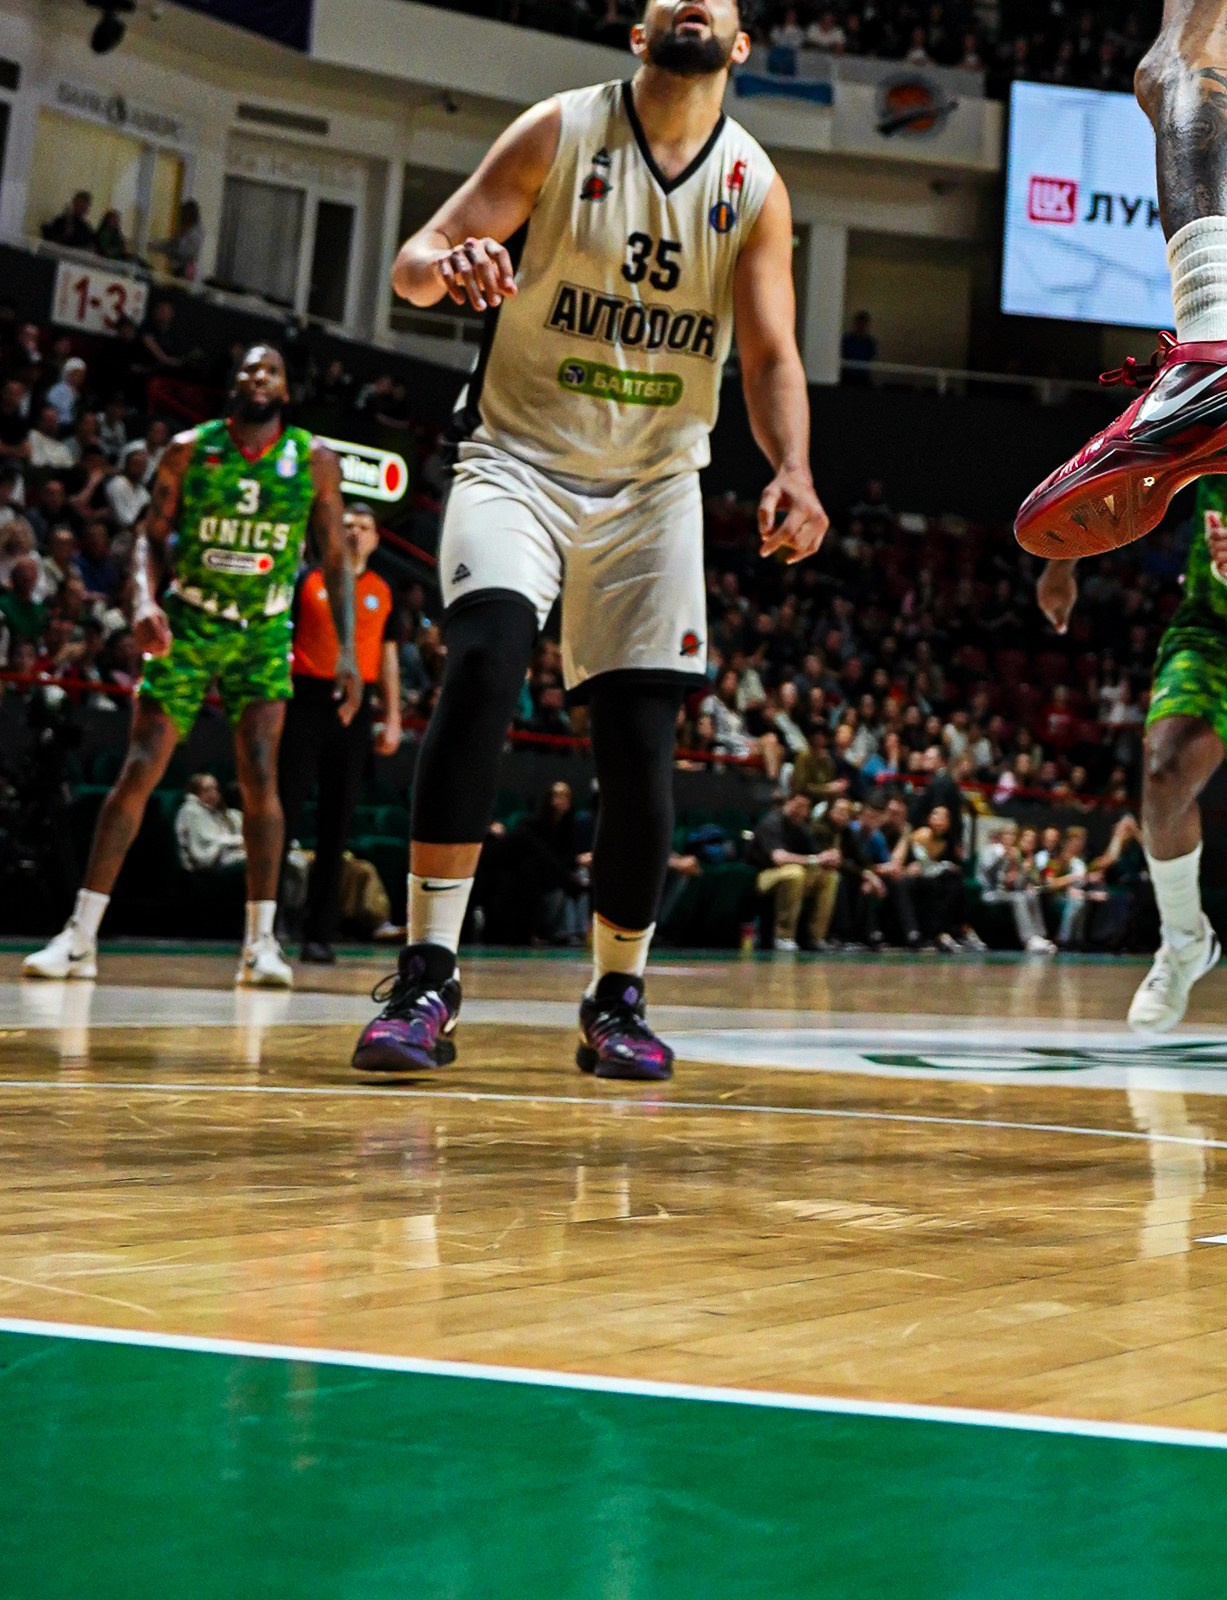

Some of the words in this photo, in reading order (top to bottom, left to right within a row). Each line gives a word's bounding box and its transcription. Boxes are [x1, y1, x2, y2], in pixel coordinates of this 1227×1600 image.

[621, 232, 682, 291] 35
[545, 280, 718, 363] AVTODOR
[236, 478, 260, 516] 3
[199, 516, 291, 551] UNICS
